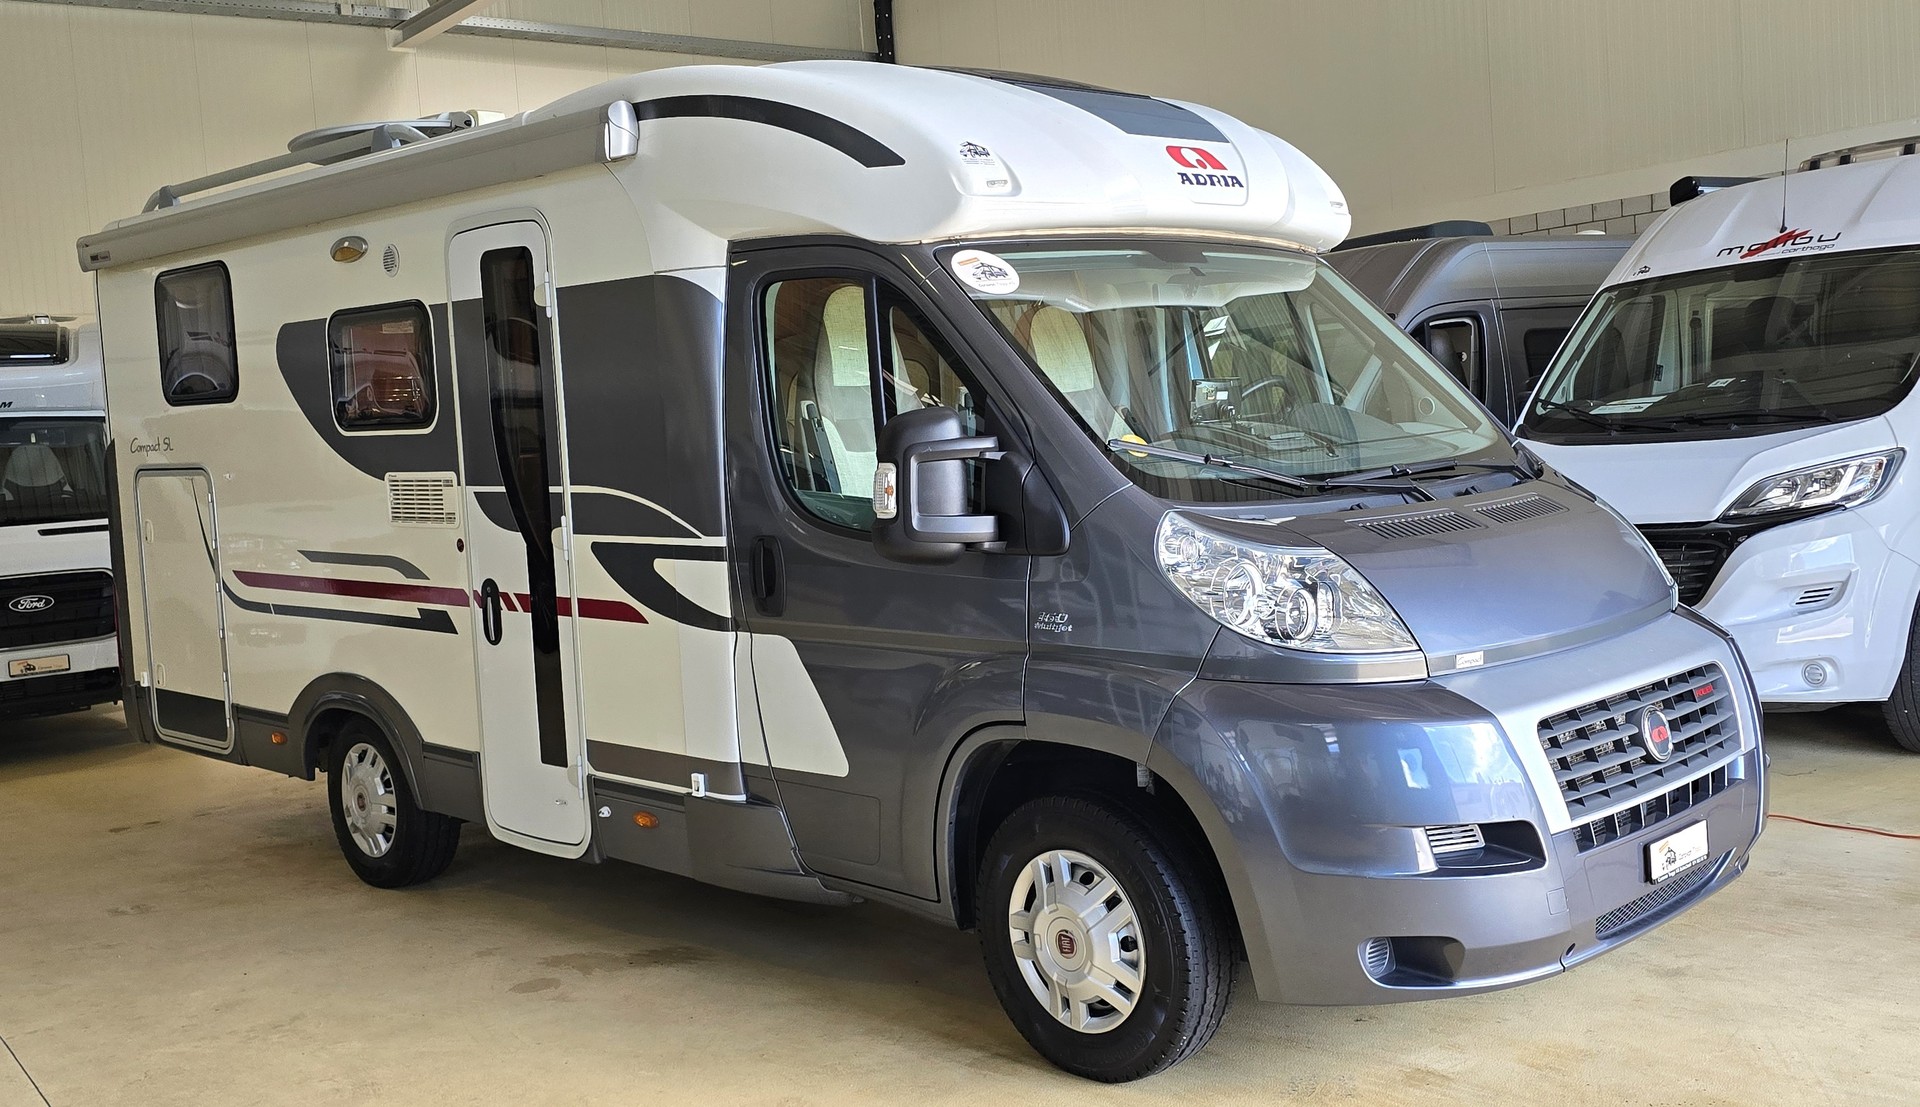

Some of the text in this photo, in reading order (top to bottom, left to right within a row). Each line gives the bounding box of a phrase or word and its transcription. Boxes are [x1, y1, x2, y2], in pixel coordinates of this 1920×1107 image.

[1177, 172, 1244, 188] ADRIA
[1781, 244, 1836, 255] carthago
[130, 436, 174, 457] Compact SL
[18, 597, 46, 610] Ford
